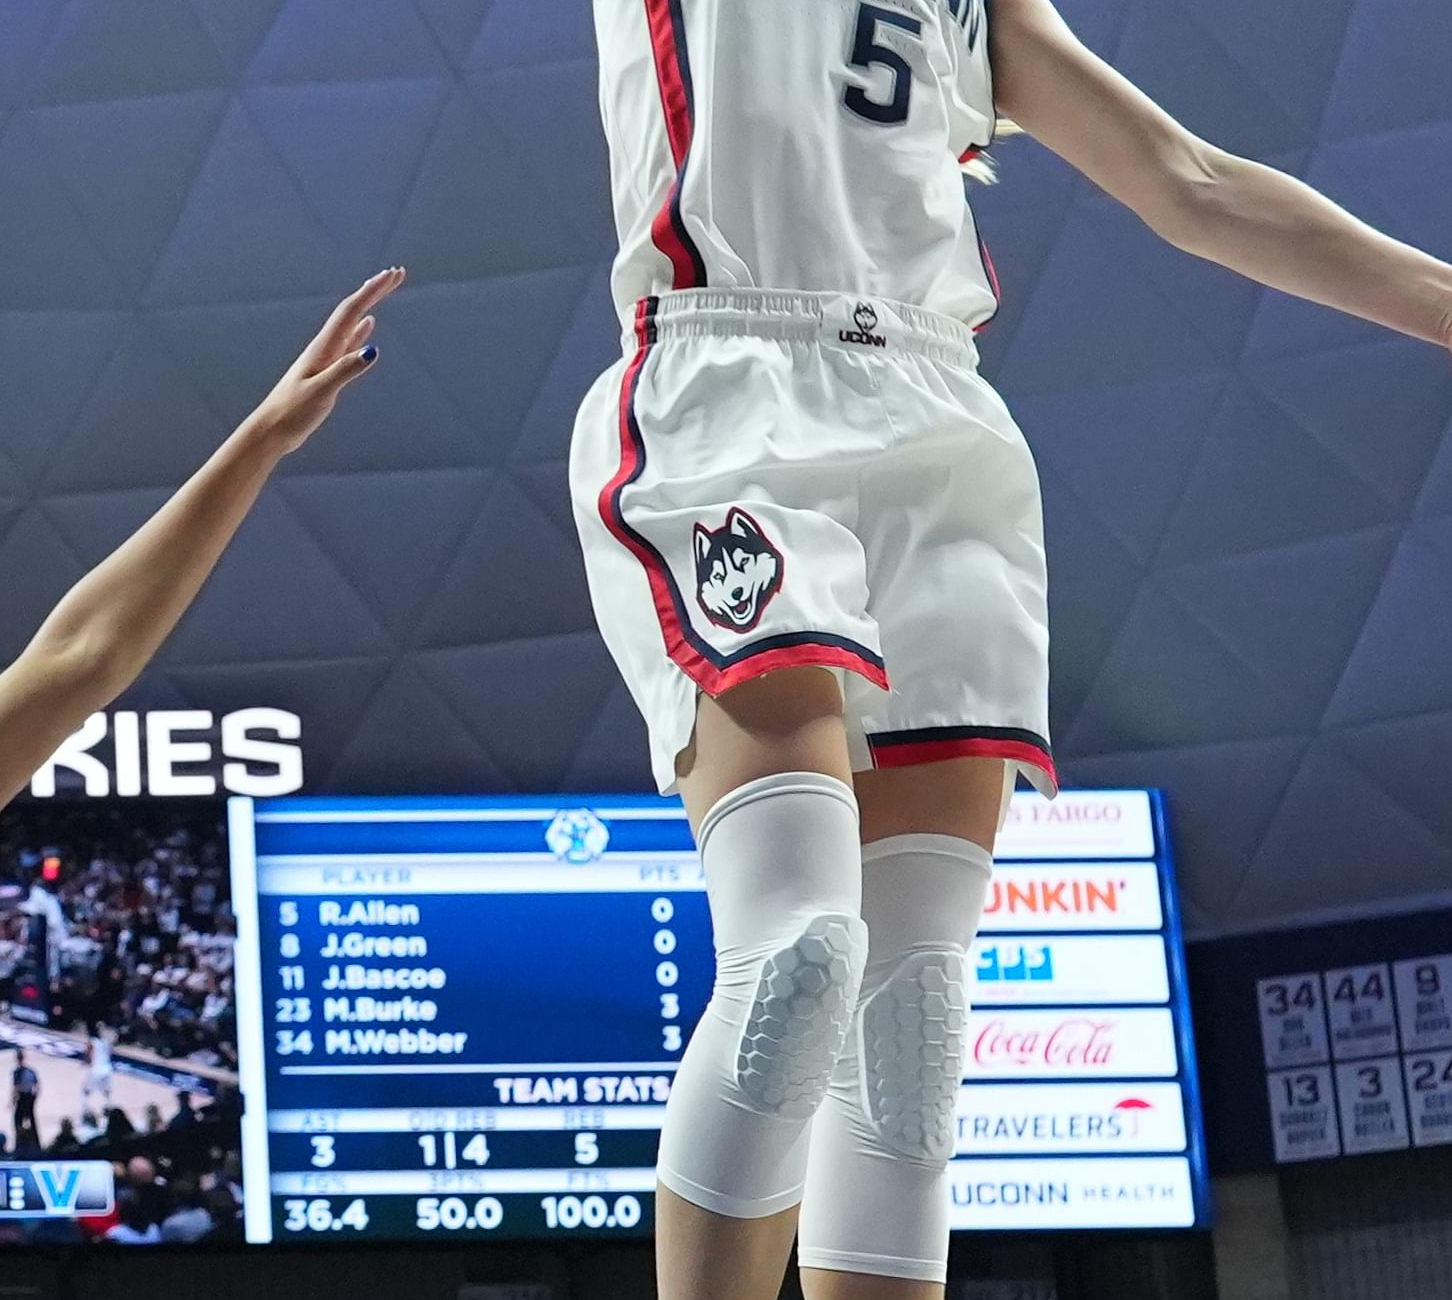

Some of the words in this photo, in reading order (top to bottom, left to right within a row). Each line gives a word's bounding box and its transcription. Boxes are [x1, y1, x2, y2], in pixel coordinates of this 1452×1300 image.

[843, 1, 924, 126] 5
[839, 329, 887, 349] UCONN
[1032, 804, 1122, 823] FARGO
[322, 868, 412, 885] PLAYER
[640, 865, 681, 883] PTS
[279, 901, 299, 927] 5
[319, 900, 421, 926] R.Allen
[651, 897, 674, 923] 0
[320, 932, 428, 958] J.Green
[654, 929, 676, 954] 0
[278, 965, 304, 991] 11
[321, 965, 447, 991] J.Bascoe
[656, 961, 679, 987] 0
[275, 997, 312, 1023] 23
[324, 995, 438, 1022] M.Burke
[660, 993, 680, 1019] 3
[1263, 979, 1315, 1017] 34
[1334, 969, 1386, 1005] 44
[275, 1029, 315, 1056] 34
[324, 1027, 469, 1055] M.Webber
[662, 1025, 682, 1051] 3
[494, 1078, 578, 1104] TEAM
[584, 1076, 671, 1103] STATS
[1283, 1074, 1320, 1107] 13
[1357, 1066, 1382, 1099] 3
[958, 1116, 1122, 1139] TRAVELERS
[310, 1135, 336, 1168] 3
[574, 1133, 599, 1165] 5
[952, 1182, 1069, 1206] UCONN
[1083, 1185, 1175, 1199] HEALTH
[283, 1199, 370, 1232] 36.4
[416, 1197, 503, 1230] 50.0
[540, 1195, 641, 1228] 100.0
